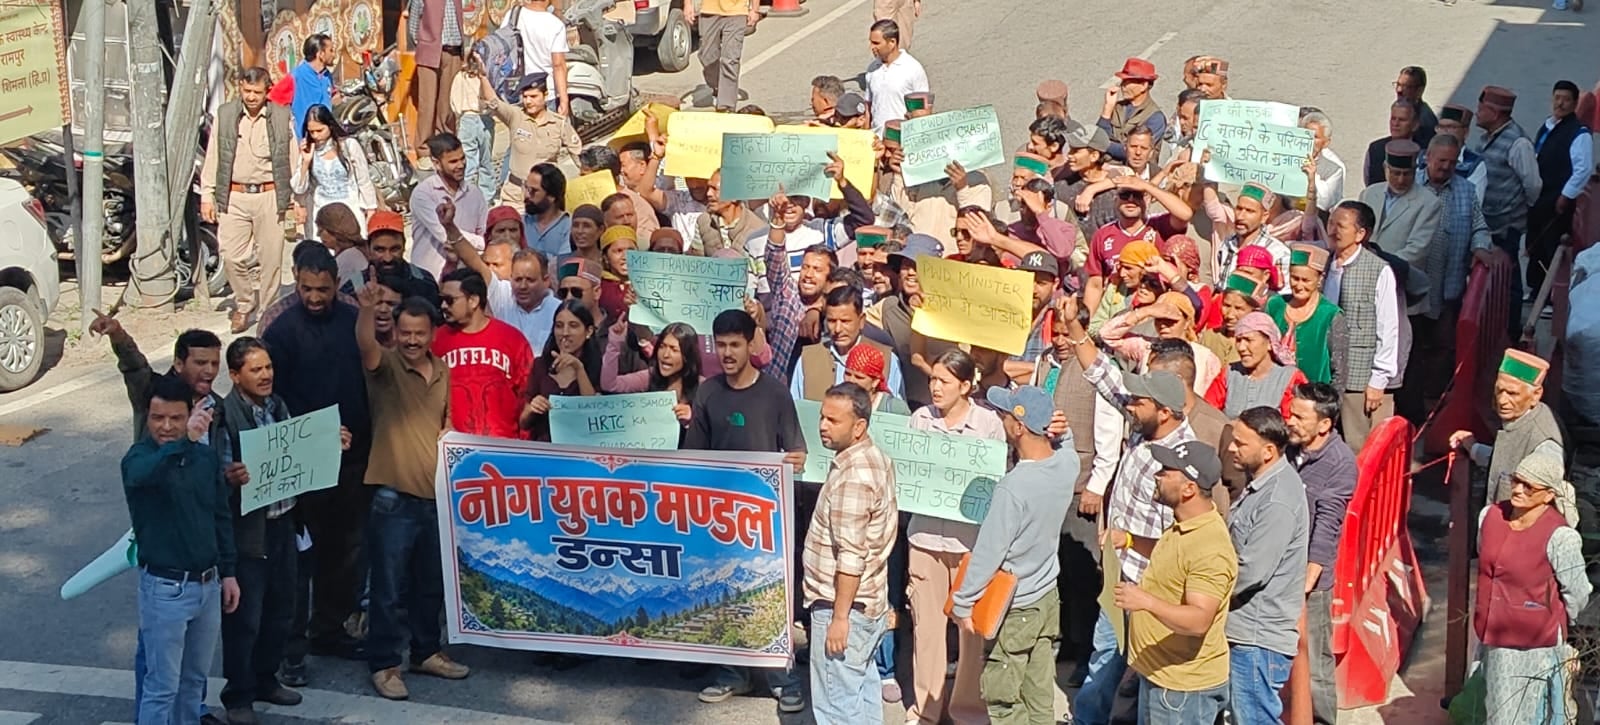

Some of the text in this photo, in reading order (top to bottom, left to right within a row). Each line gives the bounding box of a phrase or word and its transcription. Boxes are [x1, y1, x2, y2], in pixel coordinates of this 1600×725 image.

[1, 49, 25, 67] रामपुर
[2, 74, 27, 94] शिमला
[656, 258, 724, 276] TRANSPORT
[923, 262, 1025, 301] PWD MINISTER
[267, 417, 312, 451] HRTC
[588, 414, 625, 432] HRTC
[259, 455, 293, 484] PWD
[893, 458, 936, 478] लाज
[944, 467, 971, 486] का
[454, 463, 777, 552] नोग युवक मण्डल
[552, 537, 683, 578] डन्सा
